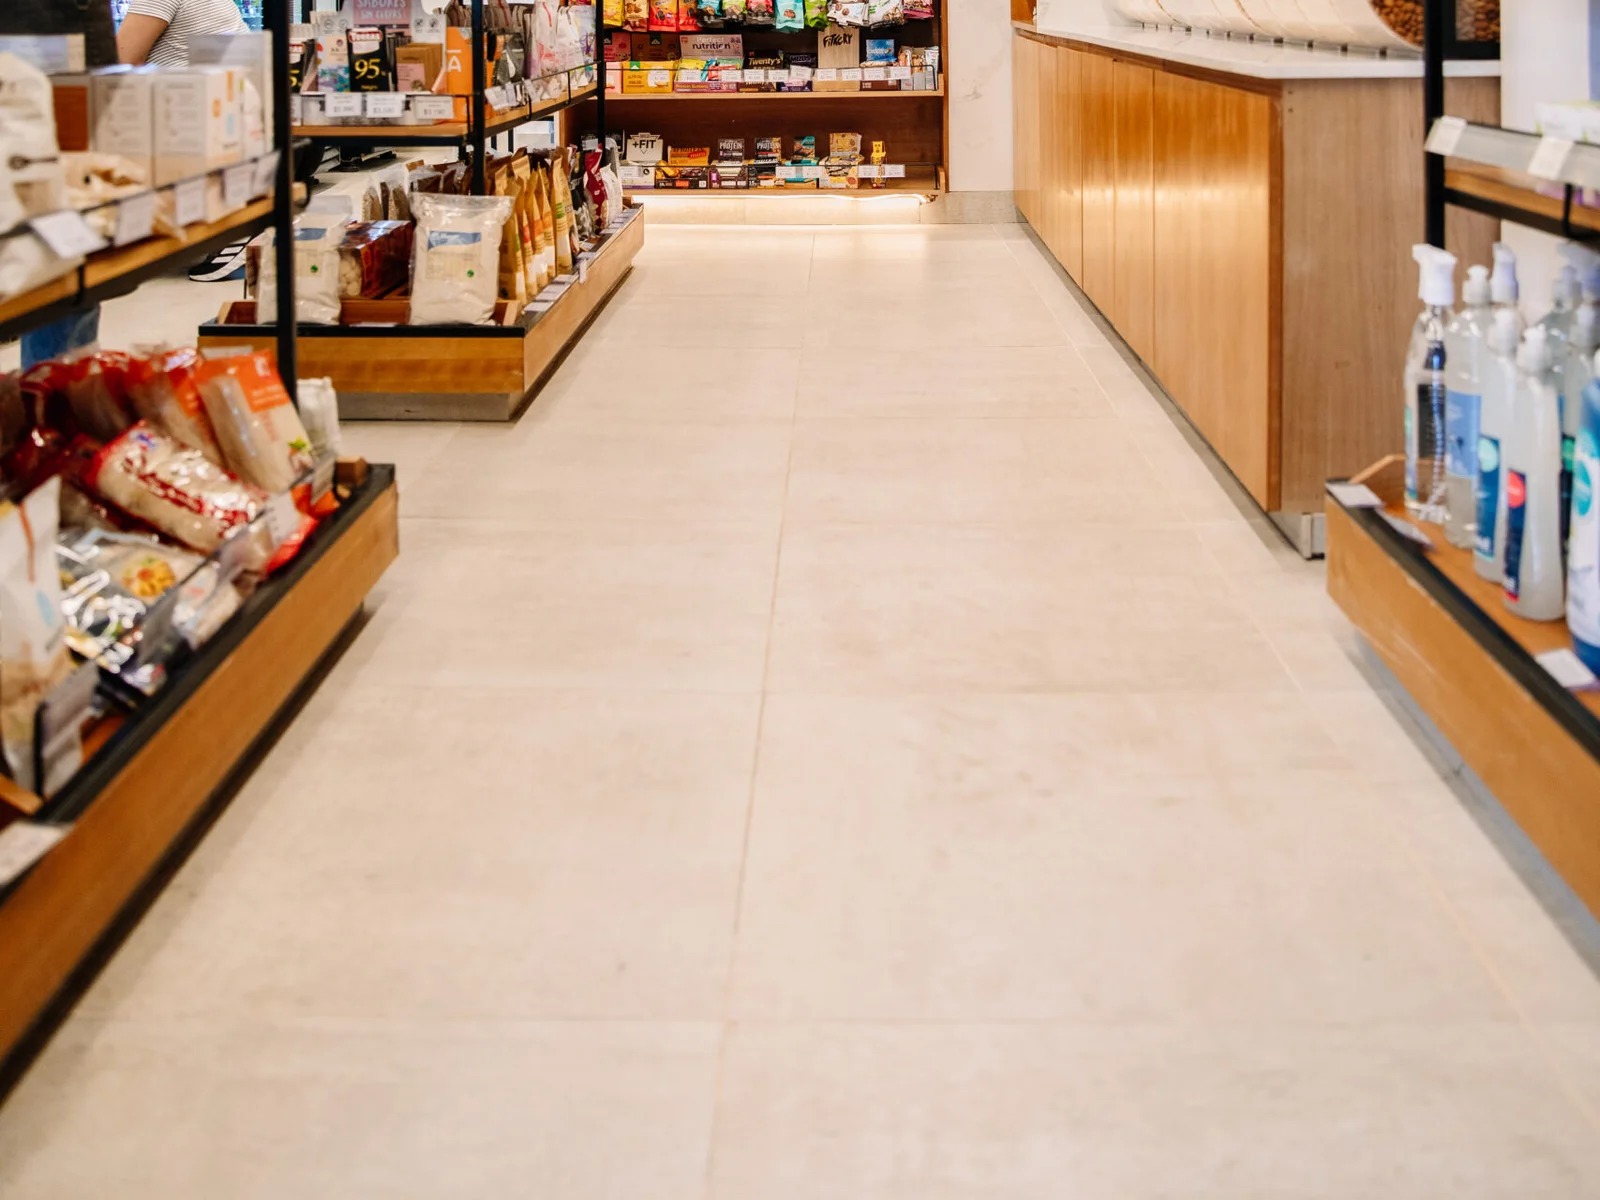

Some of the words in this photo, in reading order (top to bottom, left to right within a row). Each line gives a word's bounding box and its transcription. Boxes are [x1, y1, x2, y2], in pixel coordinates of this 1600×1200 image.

[692, 42, 731, 50] nutrition
[748, 57, 781, 66] Twenty's
[632, 139, 656, 149] +FIT
[719, 142, 743, 150] PROTEIN
